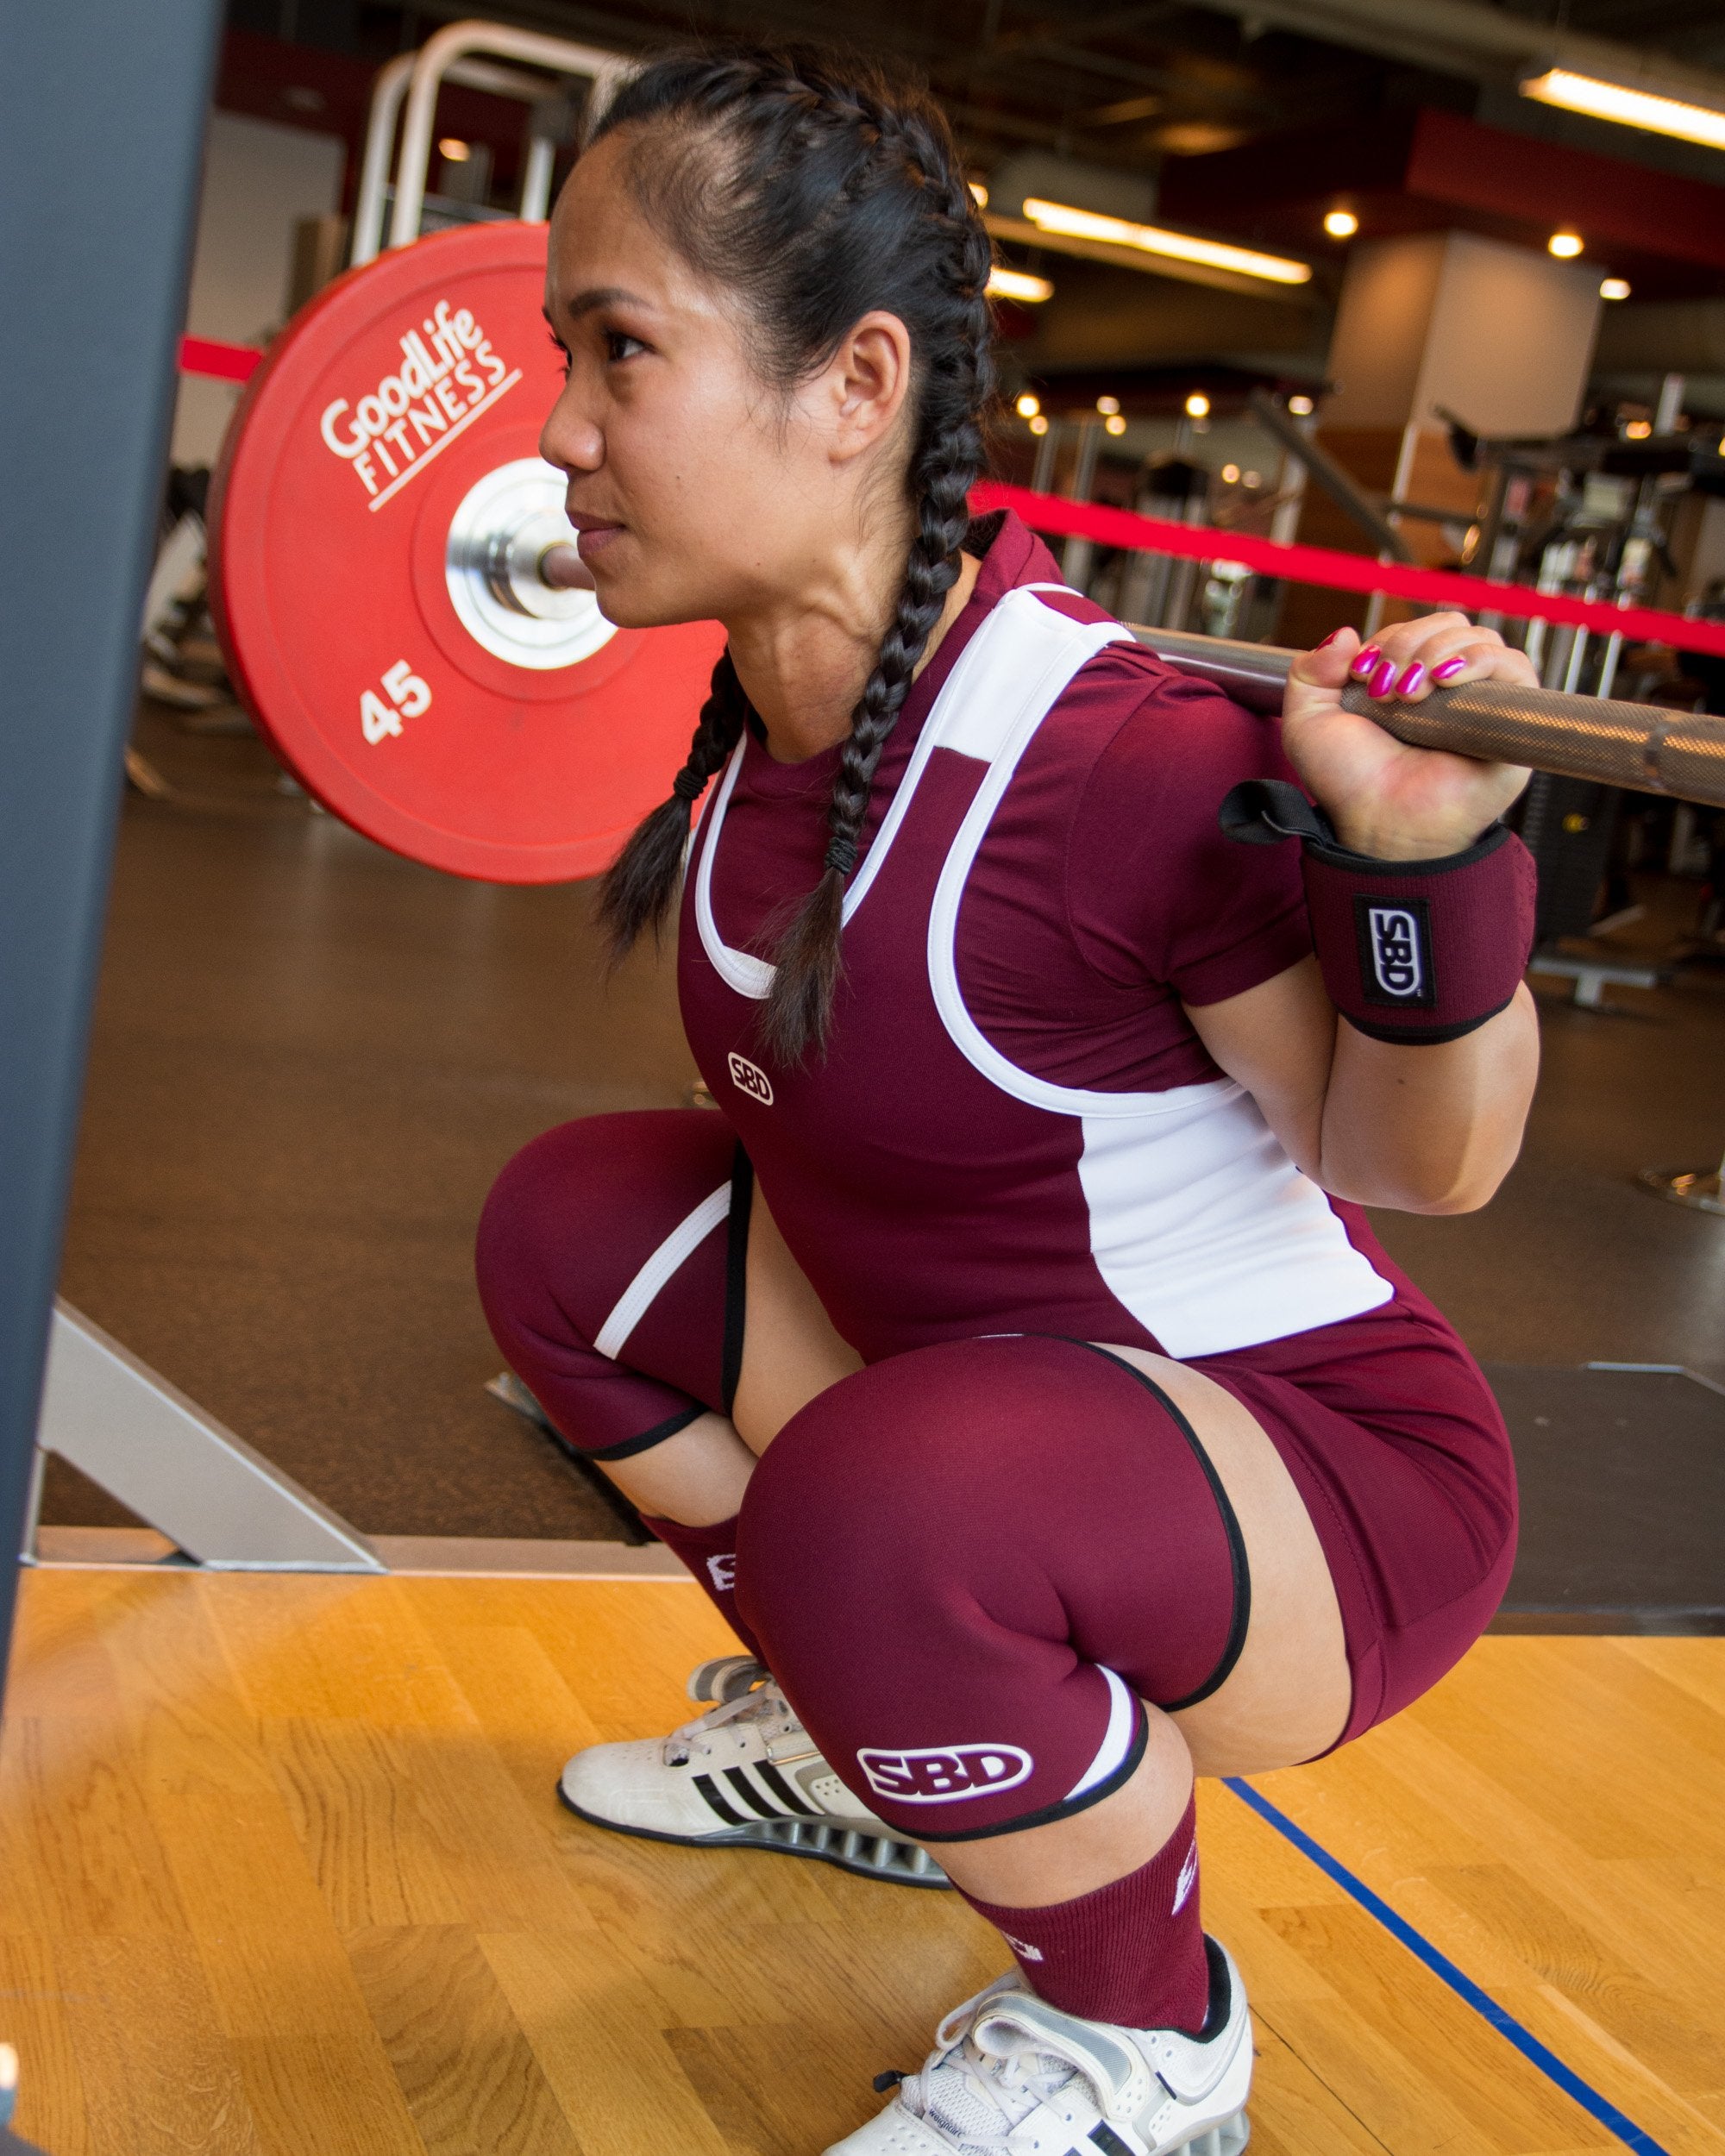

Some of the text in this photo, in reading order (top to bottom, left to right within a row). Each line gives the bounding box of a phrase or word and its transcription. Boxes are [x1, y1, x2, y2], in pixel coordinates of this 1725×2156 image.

[320, 298, 484, 460] GoodLife
[352, 338, 507, 497] FITNESS
[359, 658, 433, 747] 45
[1373, 912, 1415, 993] SBD
[731, 1056, 772, 1102] SBD
[862, 1746, 1026, 1798] SBD
